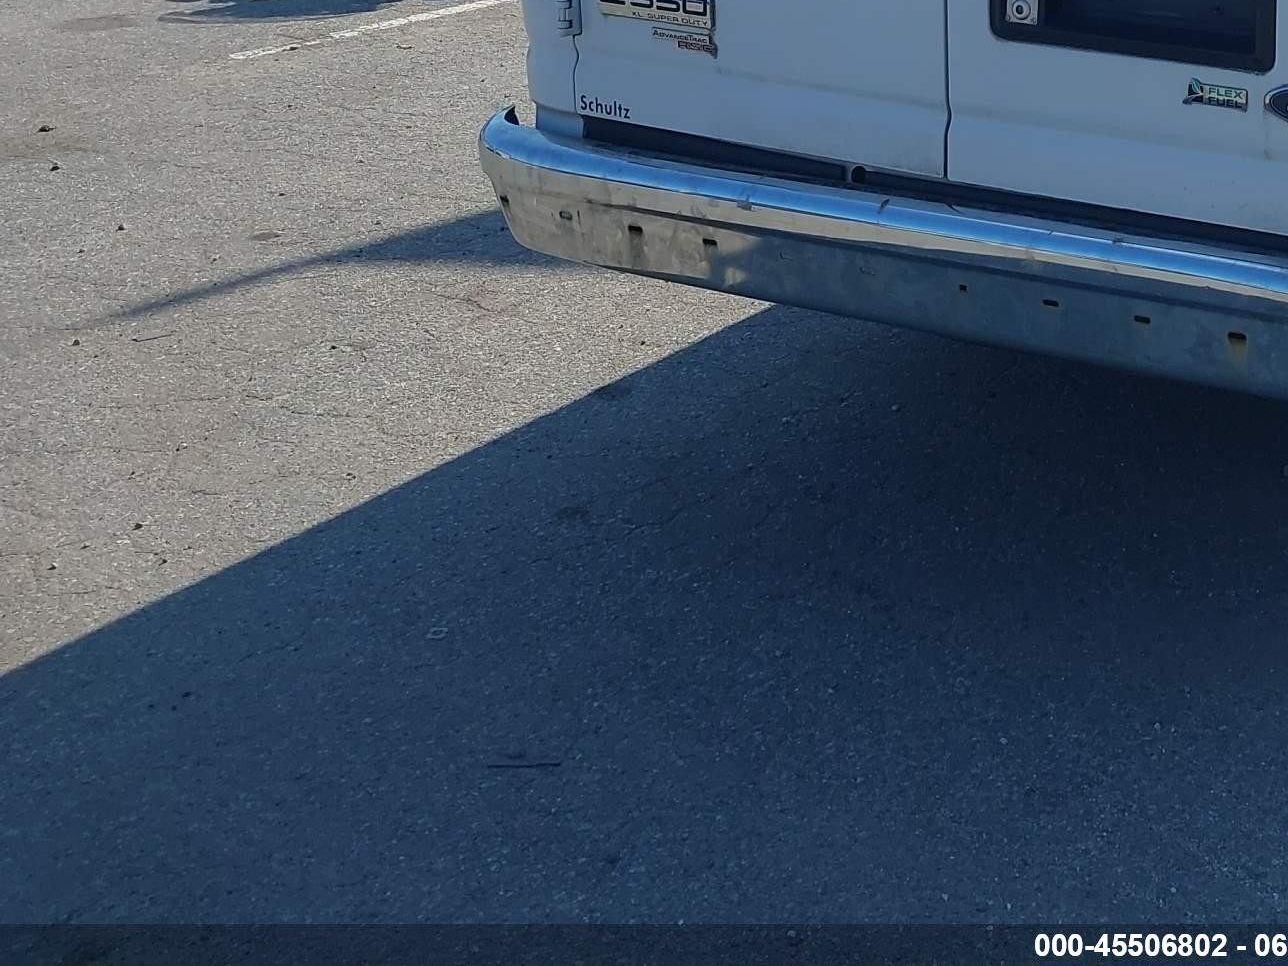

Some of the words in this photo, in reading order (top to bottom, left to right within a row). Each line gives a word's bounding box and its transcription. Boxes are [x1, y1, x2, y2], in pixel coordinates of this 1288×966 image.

[647, 13, 679, 22] SUPER
[681, 17, 708, 26] DUTY
[1208, 87, 1243, 99] FLEX
[580, 94, 631, 119] Schultz
[1208, 96, 1243, 108] FUEL
